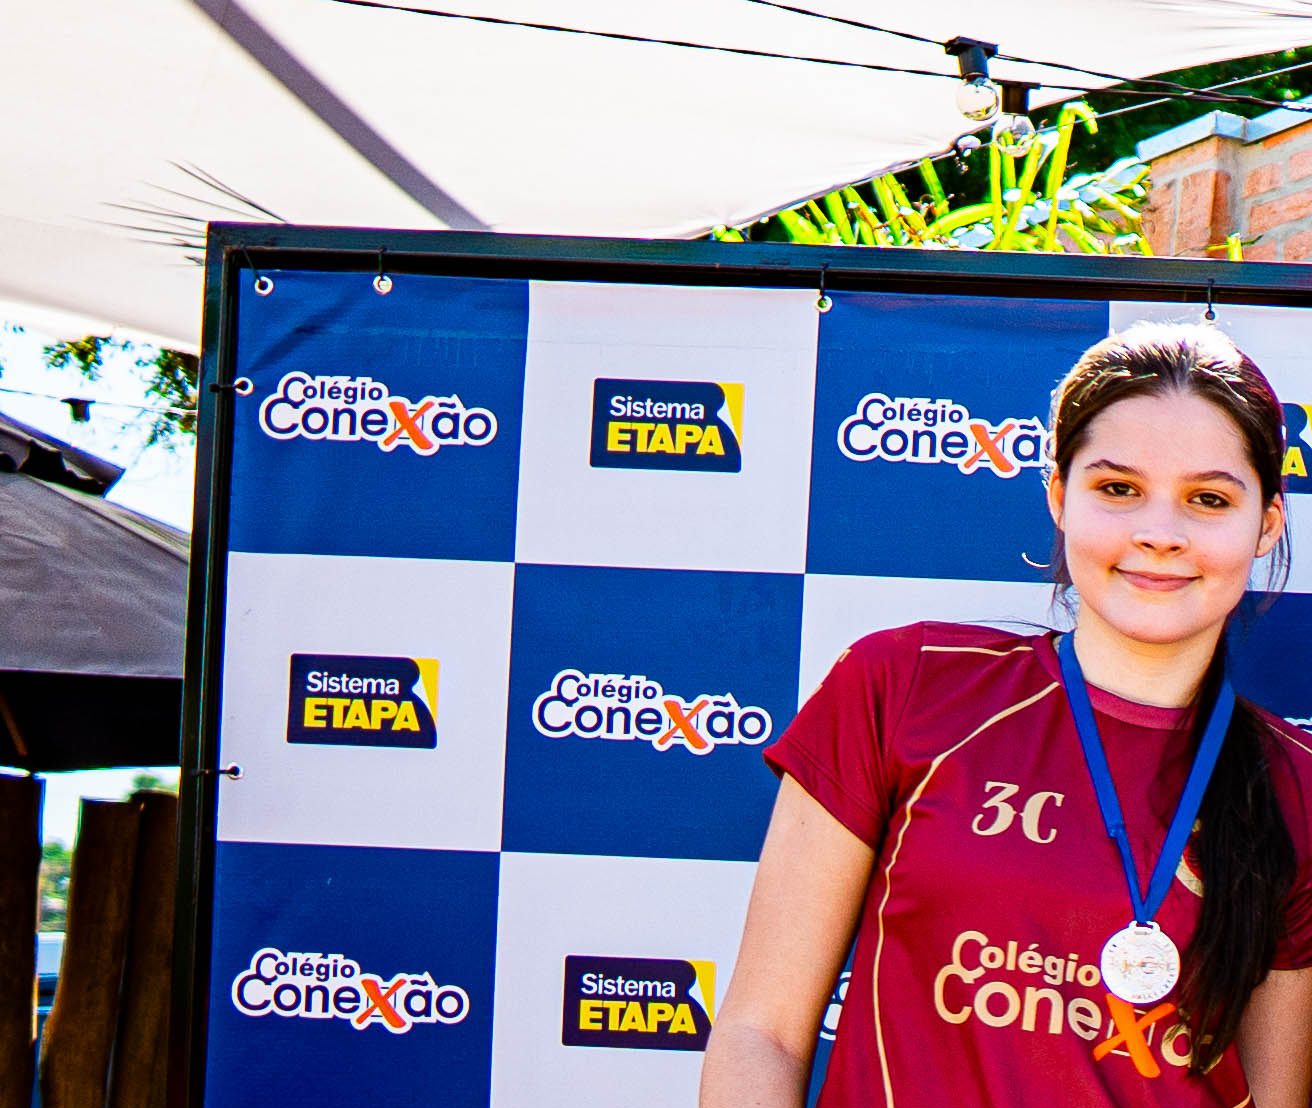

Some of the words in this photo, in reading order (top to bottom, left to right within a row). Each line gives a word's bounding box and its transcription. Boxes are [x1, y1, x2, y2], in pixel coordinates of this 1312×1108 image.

[282, 374, 384, 404] Colégio
[610, 395, 705, 421] Sistema
[862, 397, 964, 427] Colégio
[606, 420, 726, 458] ETAPA
[842, 420, 1053, 475] ConeXã
[306, 671, 400, 697] Sistema
[556, 673, 658, 704] Colégio
[302, 696, 421, 733] ETAPA
[972, 781, 1065, 844] 3C
[255, 952, 356, 982] Colégio
[952, 930, 1100, 987] Colégio
[581, 973, 677, 998] Sistema
[577, 998, 698, 1036] ETAPA
